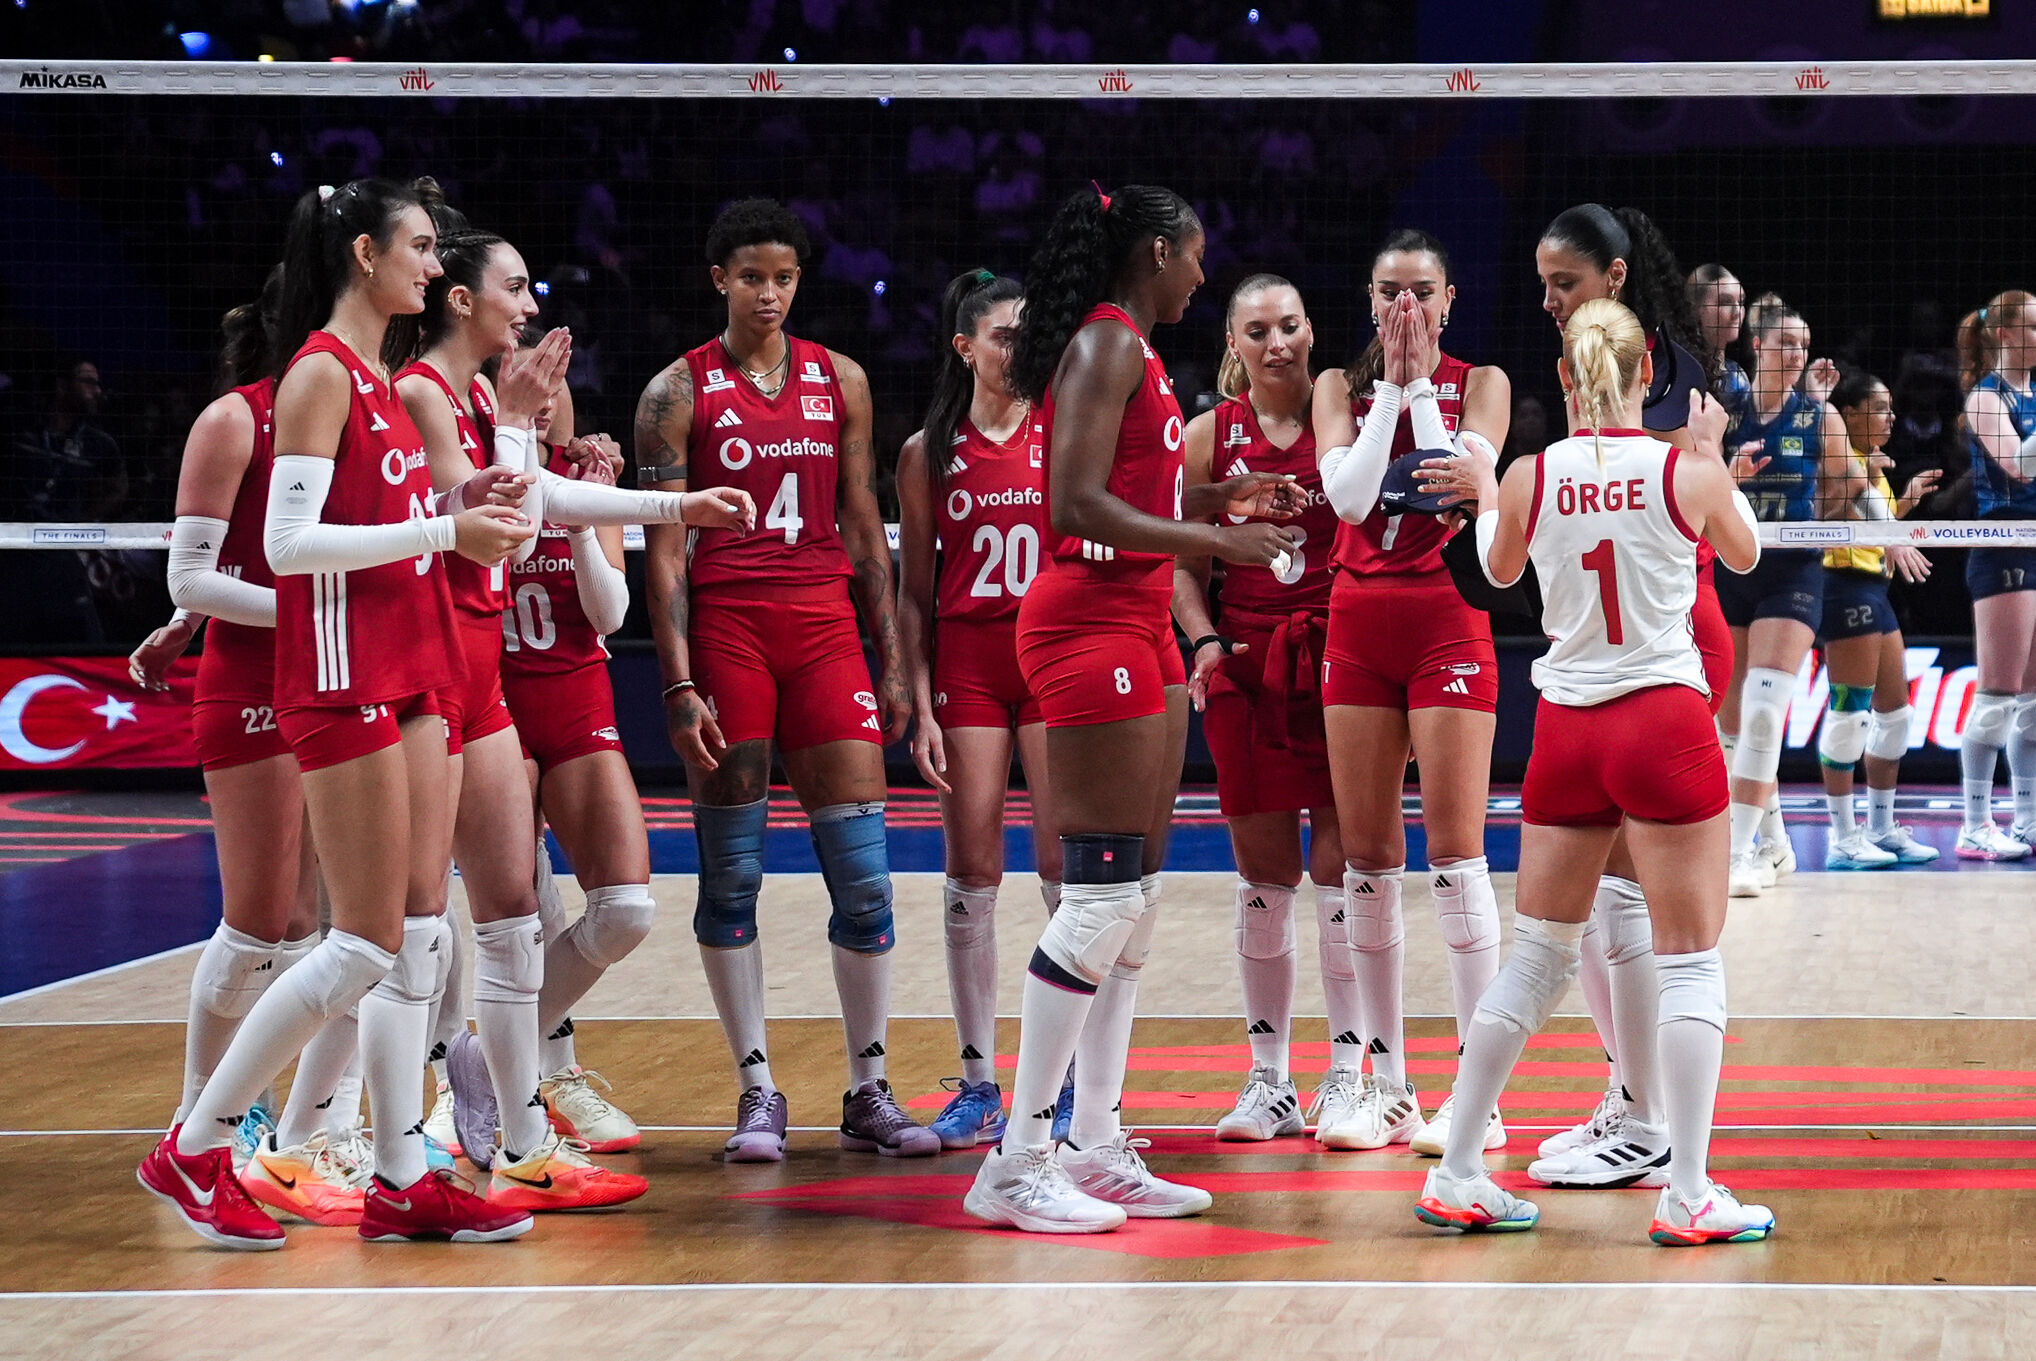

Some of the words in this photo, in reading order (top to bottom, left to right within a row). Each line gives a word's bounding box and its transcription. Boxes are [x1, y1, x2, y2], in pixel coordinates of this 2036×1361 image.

[748, 68, 784, 92] VNL
[1445, 68, 1481, 92] VNL
[756, 437, 835, 459] vodafone
[765, 472, 804, 545] 4
[976, 487, 1043, 508] vodafo
[1556, 477, 1646, 517] ÖRGE
[1789, 531, 1805, 540] THE
[1810, 531, 1842, 541] FINALS
[1934, 528, 2014, 540] VOLLEYBALL
[970, 523, 1041, 599] 20
[1582, 538, 1628, 646] 1
[1844, 604, 1874, 629] 22
[1113, 666, 1133, 695] 8
[240, 705, 278, 735] 22
